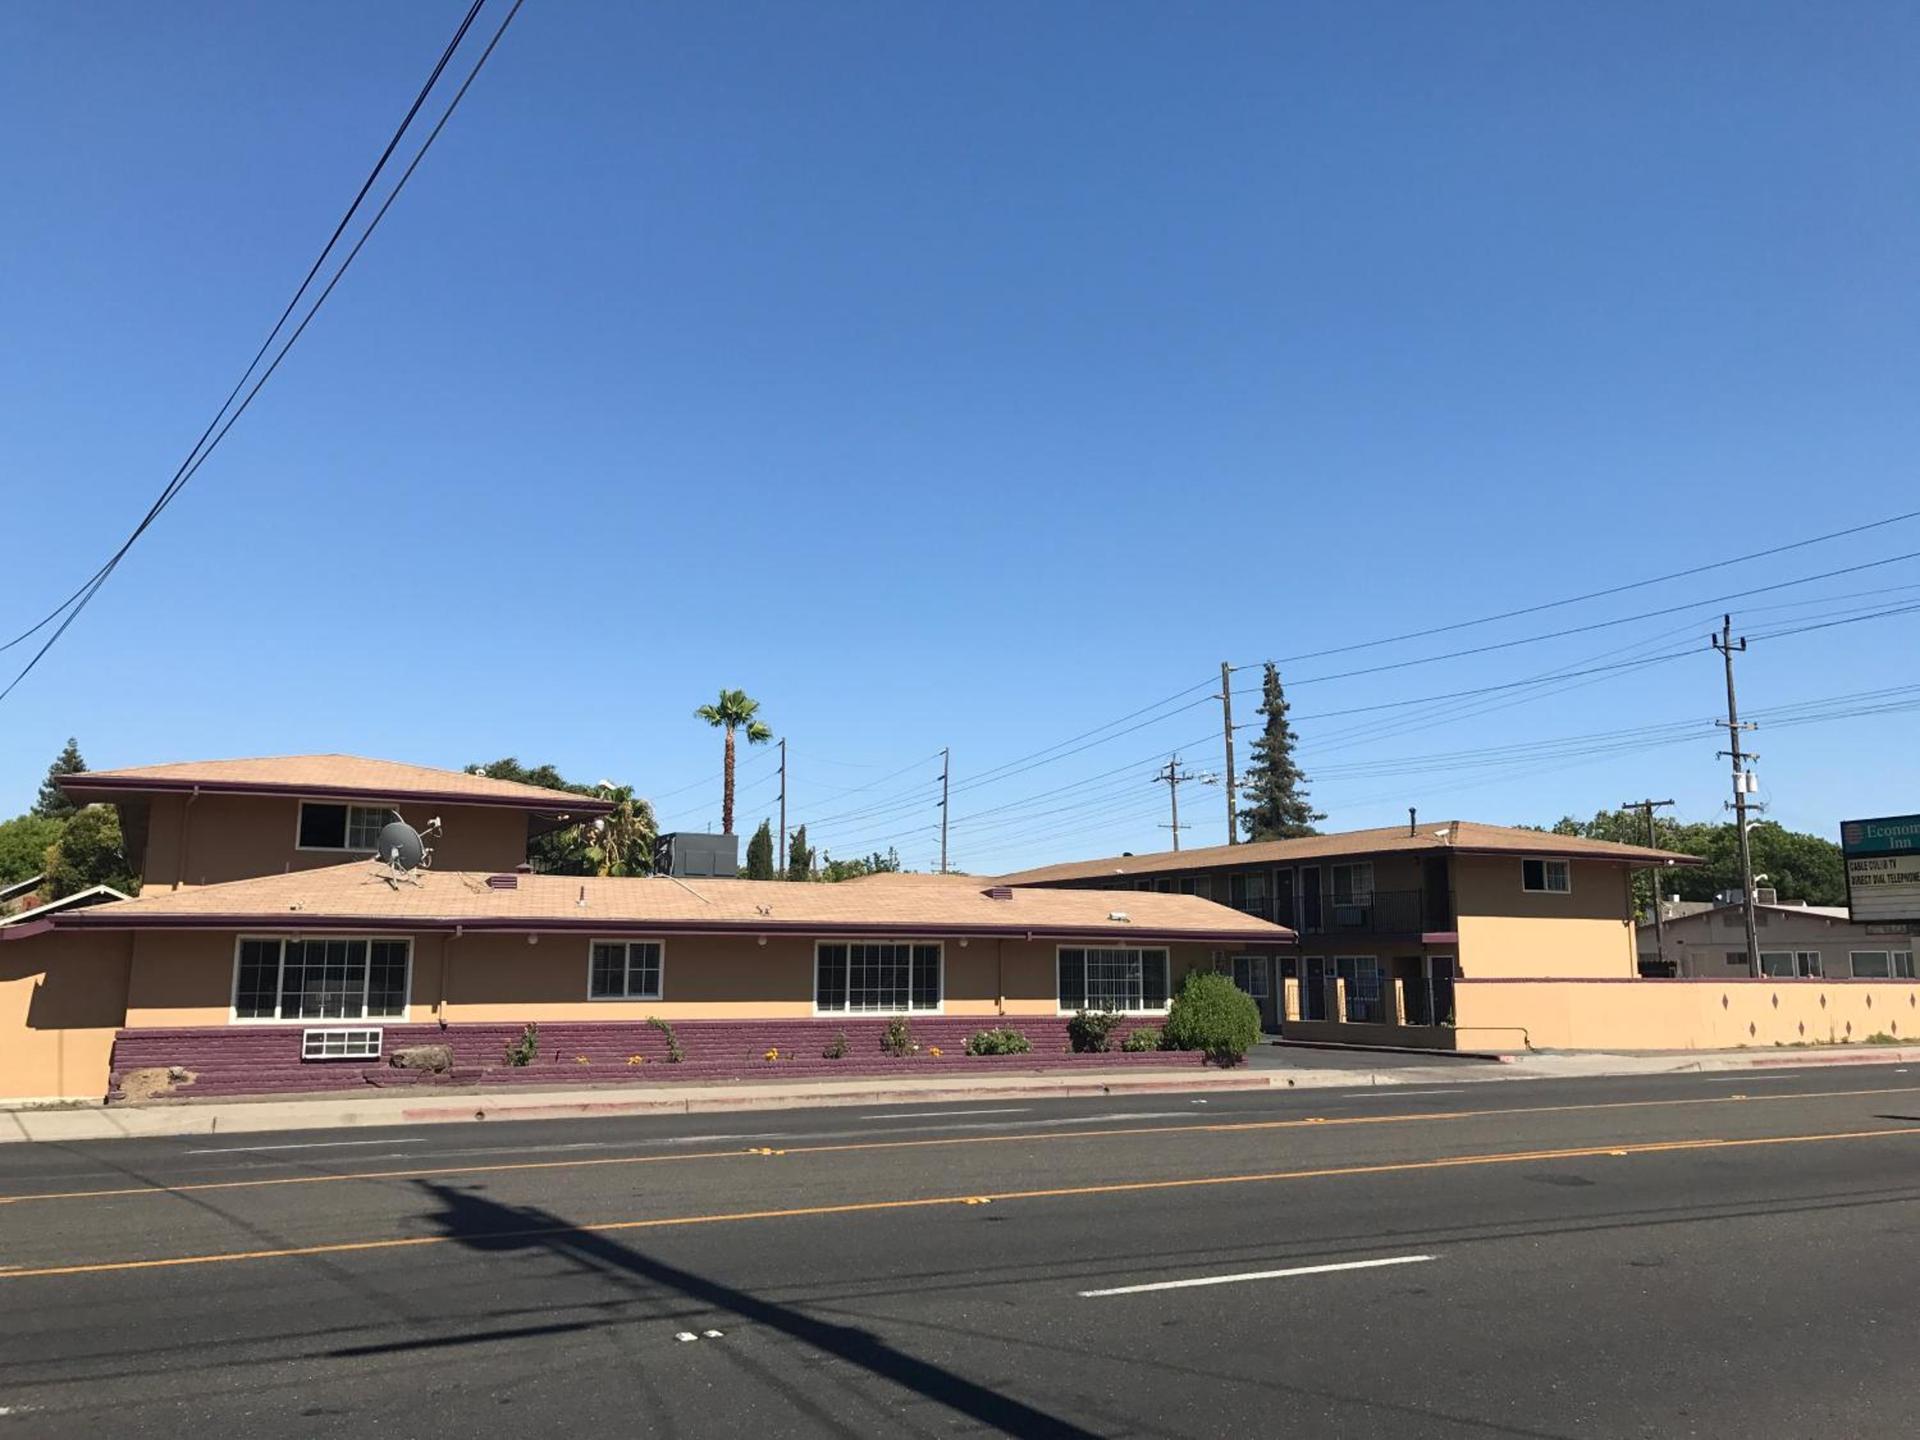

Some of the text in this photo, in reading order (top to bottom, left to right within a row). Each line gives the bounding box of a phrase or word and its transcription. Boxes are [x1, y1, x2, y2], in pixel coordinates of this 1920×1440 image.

[1867, 824, 1920, 838] Econom
[1889, 837, 1912, 849] Inn
[1849, 860, 1868, 872] CABLE
[1888, 858, 1896, 869] TV
[1851, 874, 1871, 885] DIRECT
